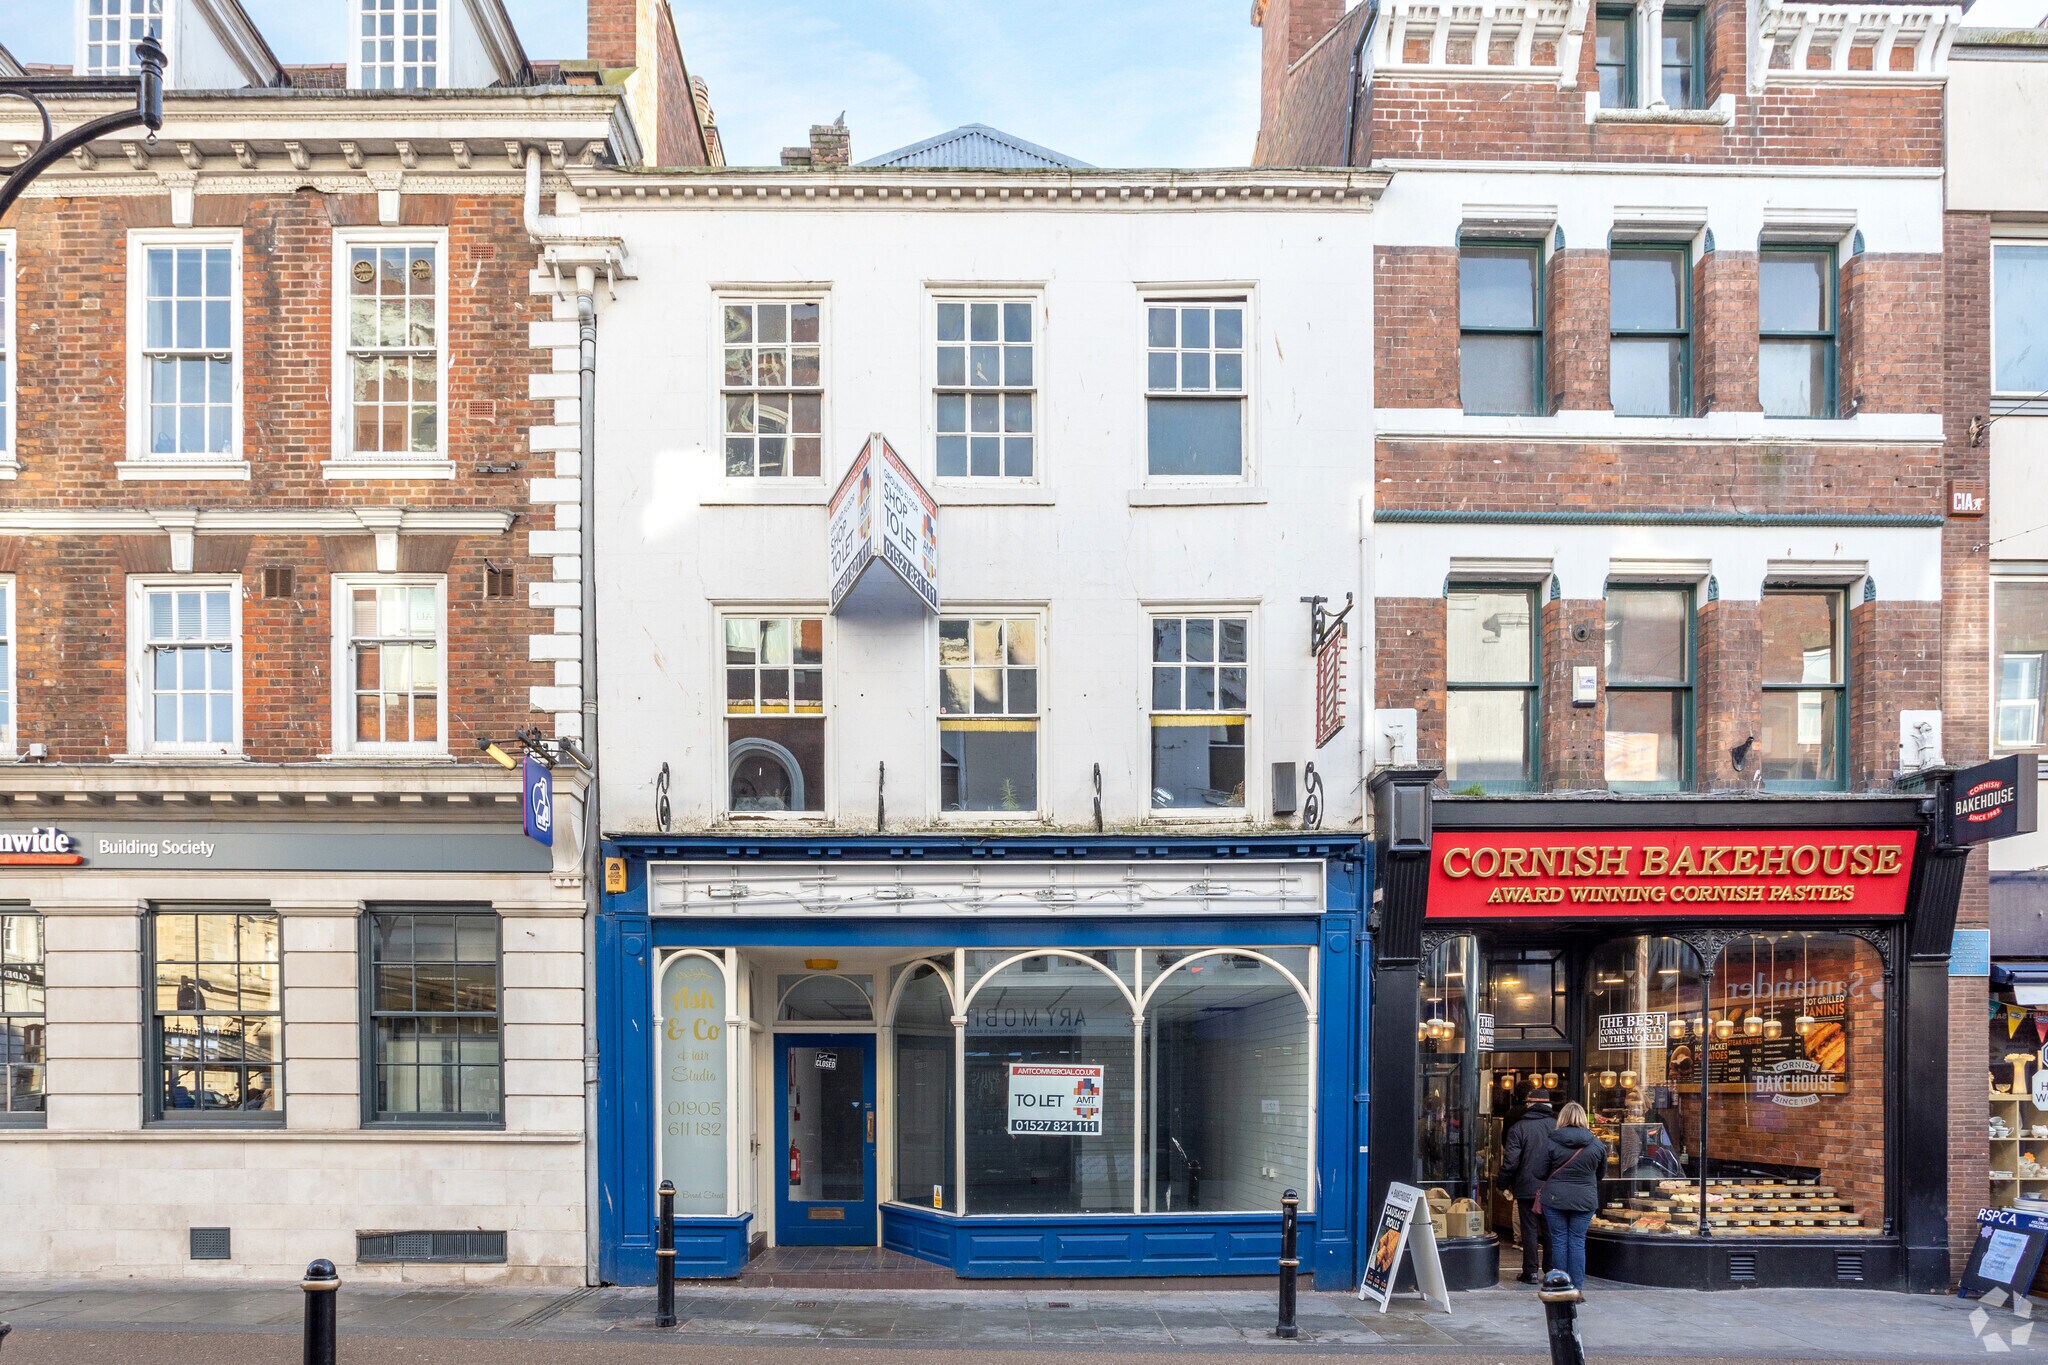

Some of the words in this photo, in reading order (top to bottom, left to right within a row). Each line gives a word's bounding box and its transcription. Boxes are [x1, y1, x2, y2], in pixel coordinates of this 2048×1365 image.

[884, 468, 904, 497] GROUND
[904, 490, 919, 516] FLOOR
[884, 483, 908, 519] SHOP
[1953, 492, 1973, 511] CIA
[831, 520, 847, 555] SHOP
[884, 504, 900, 536] TO
[901, 521, 917, 555] LET
[831, 549, 842, 578] TO
[842, 528, 854, 564] LET
[922, 539, 935, 559] AMT
[885, 541, 909, 575] 01527
[909, 567, 923, 591] 821
[923, 579, 936, 604] 111
[1970, 781, 2000, 796] CORNISH
[1956, 786, 2014, 816] BAKEHOUSE
[1969, 813, 1987, 821] SINCE
[0, 827, 70, 852] nwide
[99, 839, 158, 858] Building
[161, 840, 215, 858] Society
[1443, 846, 1632, 878] CORNISH
[1640, 844, 1903, 877] BAKEHOUSE
[1487, 887, 1565, 904] AWARD
[1569, 886, 1668, 903] WINNING
[1670, 885, 1765, 902] CORNISH
[1767, 885, 1856, 902] PASTIES
[672, 986, 716, 1012] Ash
[1817, 995, 1845, 1004] GRILLED
[667, 1017, 686, 1041] &
[693, 1017, 720, 1041] Co
[1601, 1016, 1624, 1029] THE
[1627, 1014, 1665, 1027] BEST
[1600, 1027, 1633, 1036] CORNISH
[1635, 1025, 1664, 1034] PASTY
[1609, 1035, 1625, 1043] THE
[1626, 1033, 1664, 1042] WORLD
[677, 1044, 710, 1061] Hair
[816, 1060, 836, 1069] CLOSED
[1017, 1068, 1096, 1077] AMTCOMMERCIAL.CO.UK
[1775, 1060, 1817, 1072] CORNISH
[671, 1065, 717, 1083] Studio
[1756, 1074, 1836, 1093] BAKEHOUSE
[668, 1101, 721, 1116] 01905
[1014, 1094, 1036, 1107] TO
[1039, 1095, 1065, 1108] LET
[1076, 1096, 1096, 1104] AMT
[1775, 1096, 1799, 1106] SINCE
[1800, 1096, 1817, 1106] 1983
[668, 1122, 690, 1136] 611
[696, 1122, 722, 1136] 182
[1016, 1120, 1051, 1131] 01527
[1053, 1121, 1073, 1132] 821
[1076, 1122, 1095, 1132] 111
[1385, 1205, 1406, 1221] SAUSAGE
[1977, 1208, 2017, 1226] RSPCA
[1385, 1216, 1401, 1231] ROLLS
